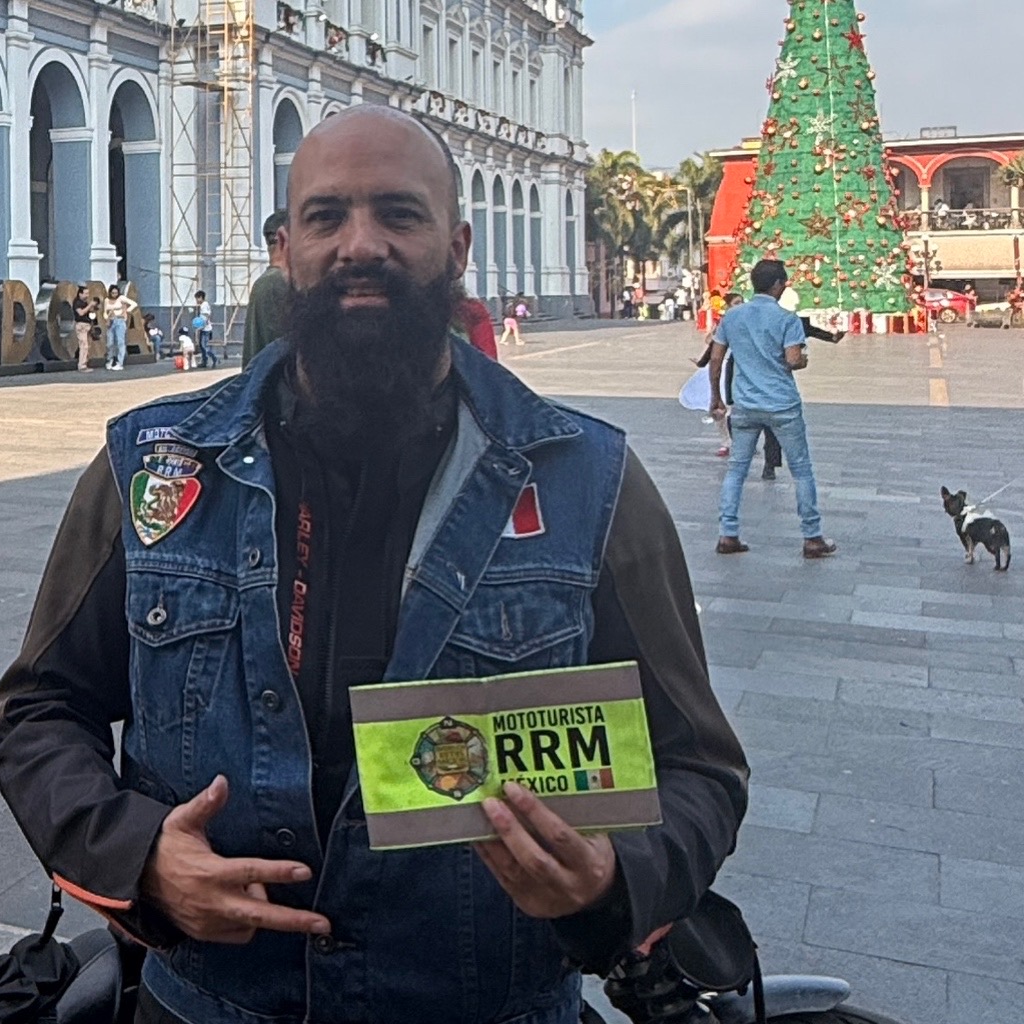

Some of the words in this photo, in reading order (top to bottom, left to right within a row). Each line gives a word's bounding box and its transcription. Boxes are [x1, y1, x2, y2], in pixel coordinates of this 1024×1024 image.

[492, 705, 605, 733] MOTOTURISTA
[495, 725, 612, 774] RRM
[501, 775, 569, 794] XICO
